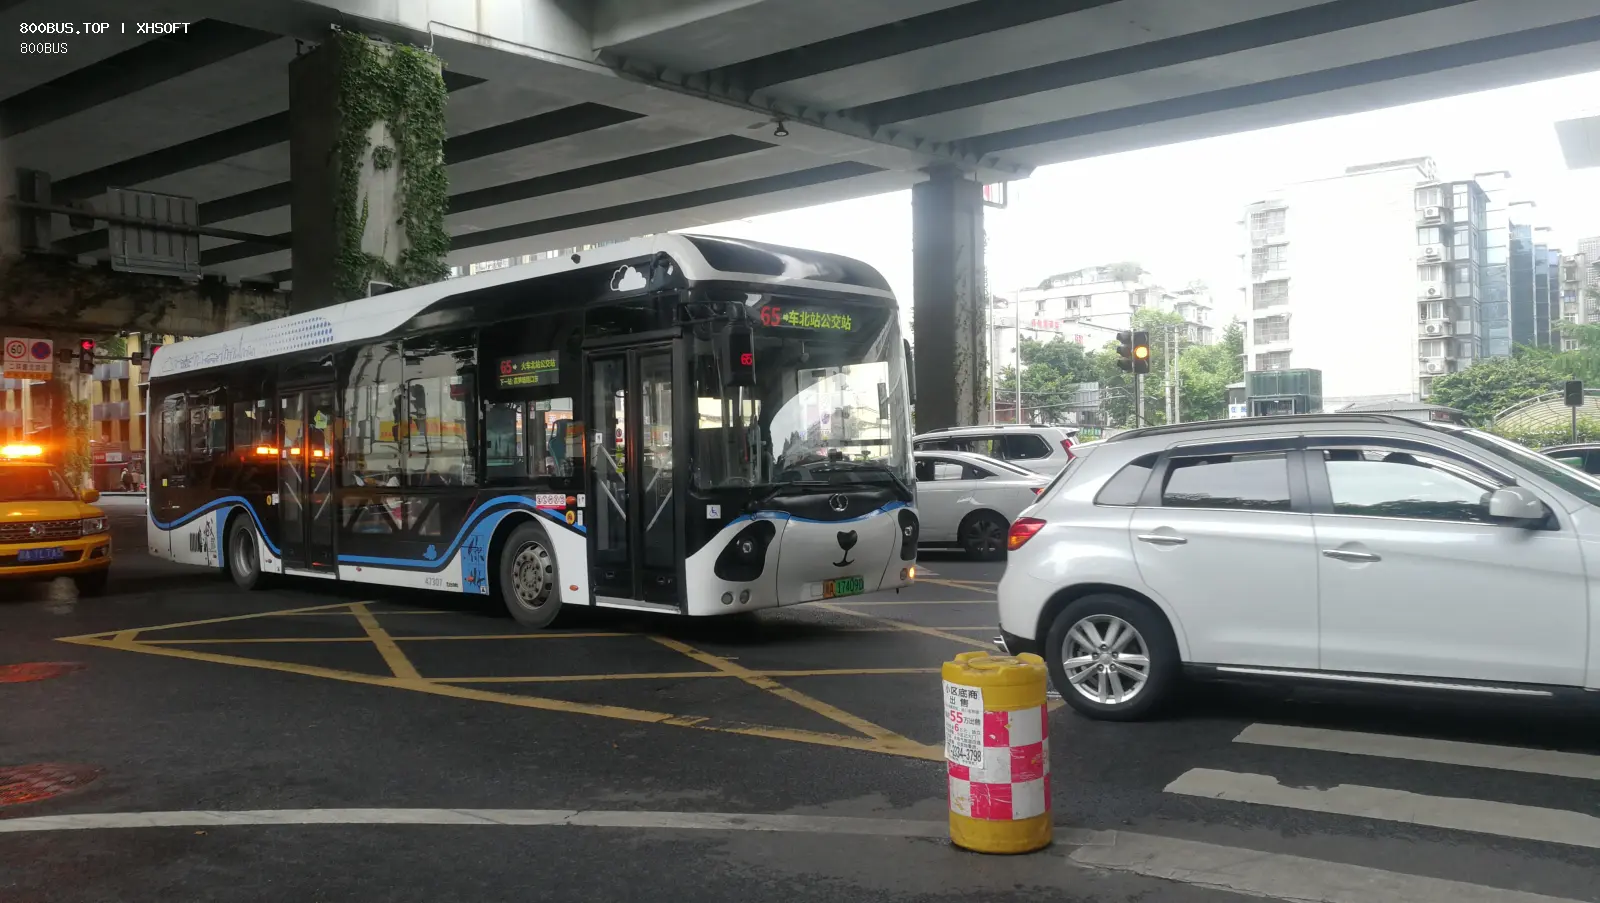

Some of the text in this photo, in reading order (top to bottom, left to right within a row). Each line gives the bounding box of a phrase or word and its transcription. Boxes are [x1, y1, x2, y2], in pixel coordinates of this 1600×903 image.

[760, 306, 852, 331] 65 车北站公交站
[10, 344, 22, 355] 60
[741, 352, 753, 366] 65
[500, 359, 513, 376] 65
[945, 683, 978, 699] 小区底商
